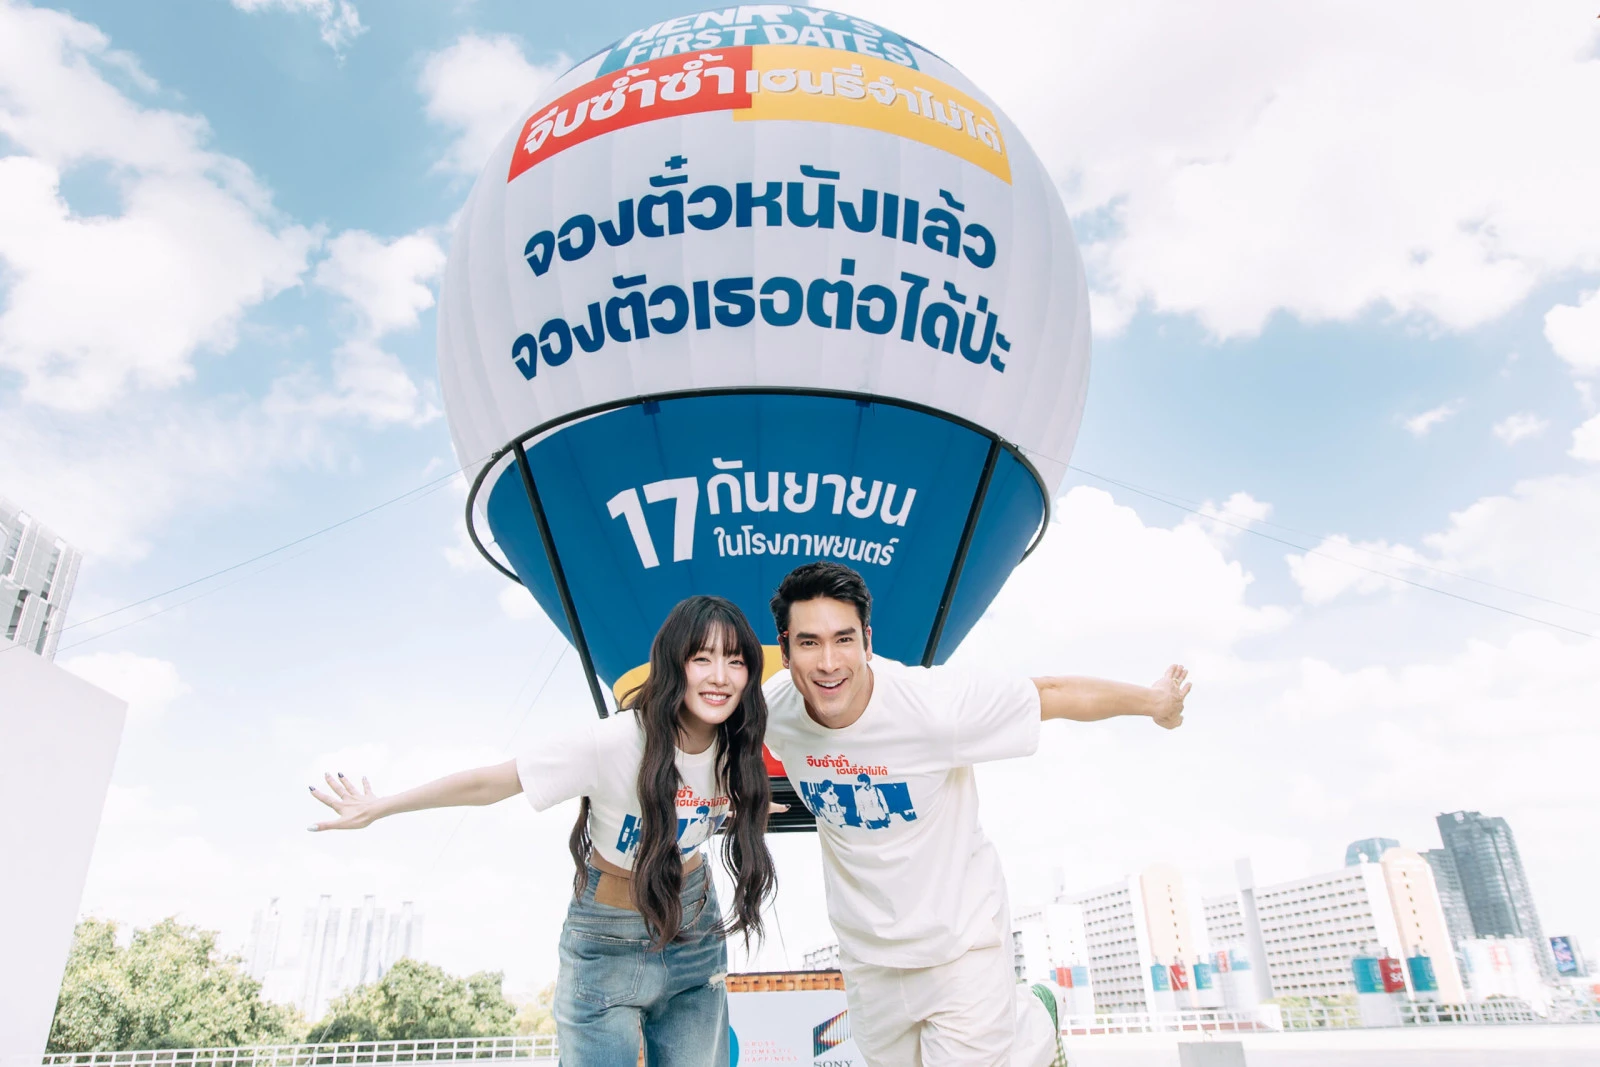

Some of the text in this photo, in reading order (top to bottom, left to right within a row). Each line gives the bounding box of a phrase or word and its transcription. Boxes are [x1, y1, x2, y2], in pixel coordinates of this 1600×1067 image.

[762, 24, 914, 67] DATES
[523, 53, 1003, 154] จีบซ้ำซ้ำ เฮนรี่จำไม่ได้
[524, 154, 997, 277] จองตั๋วหนังแล้ว
[511, 258, 1012, 381] จองตัวเธอต่อได้ป่ะ
[606, 457, 917, 569] 17 กันยายน
[713, 525, 900, 566] ในโรงภาพยนตร์
